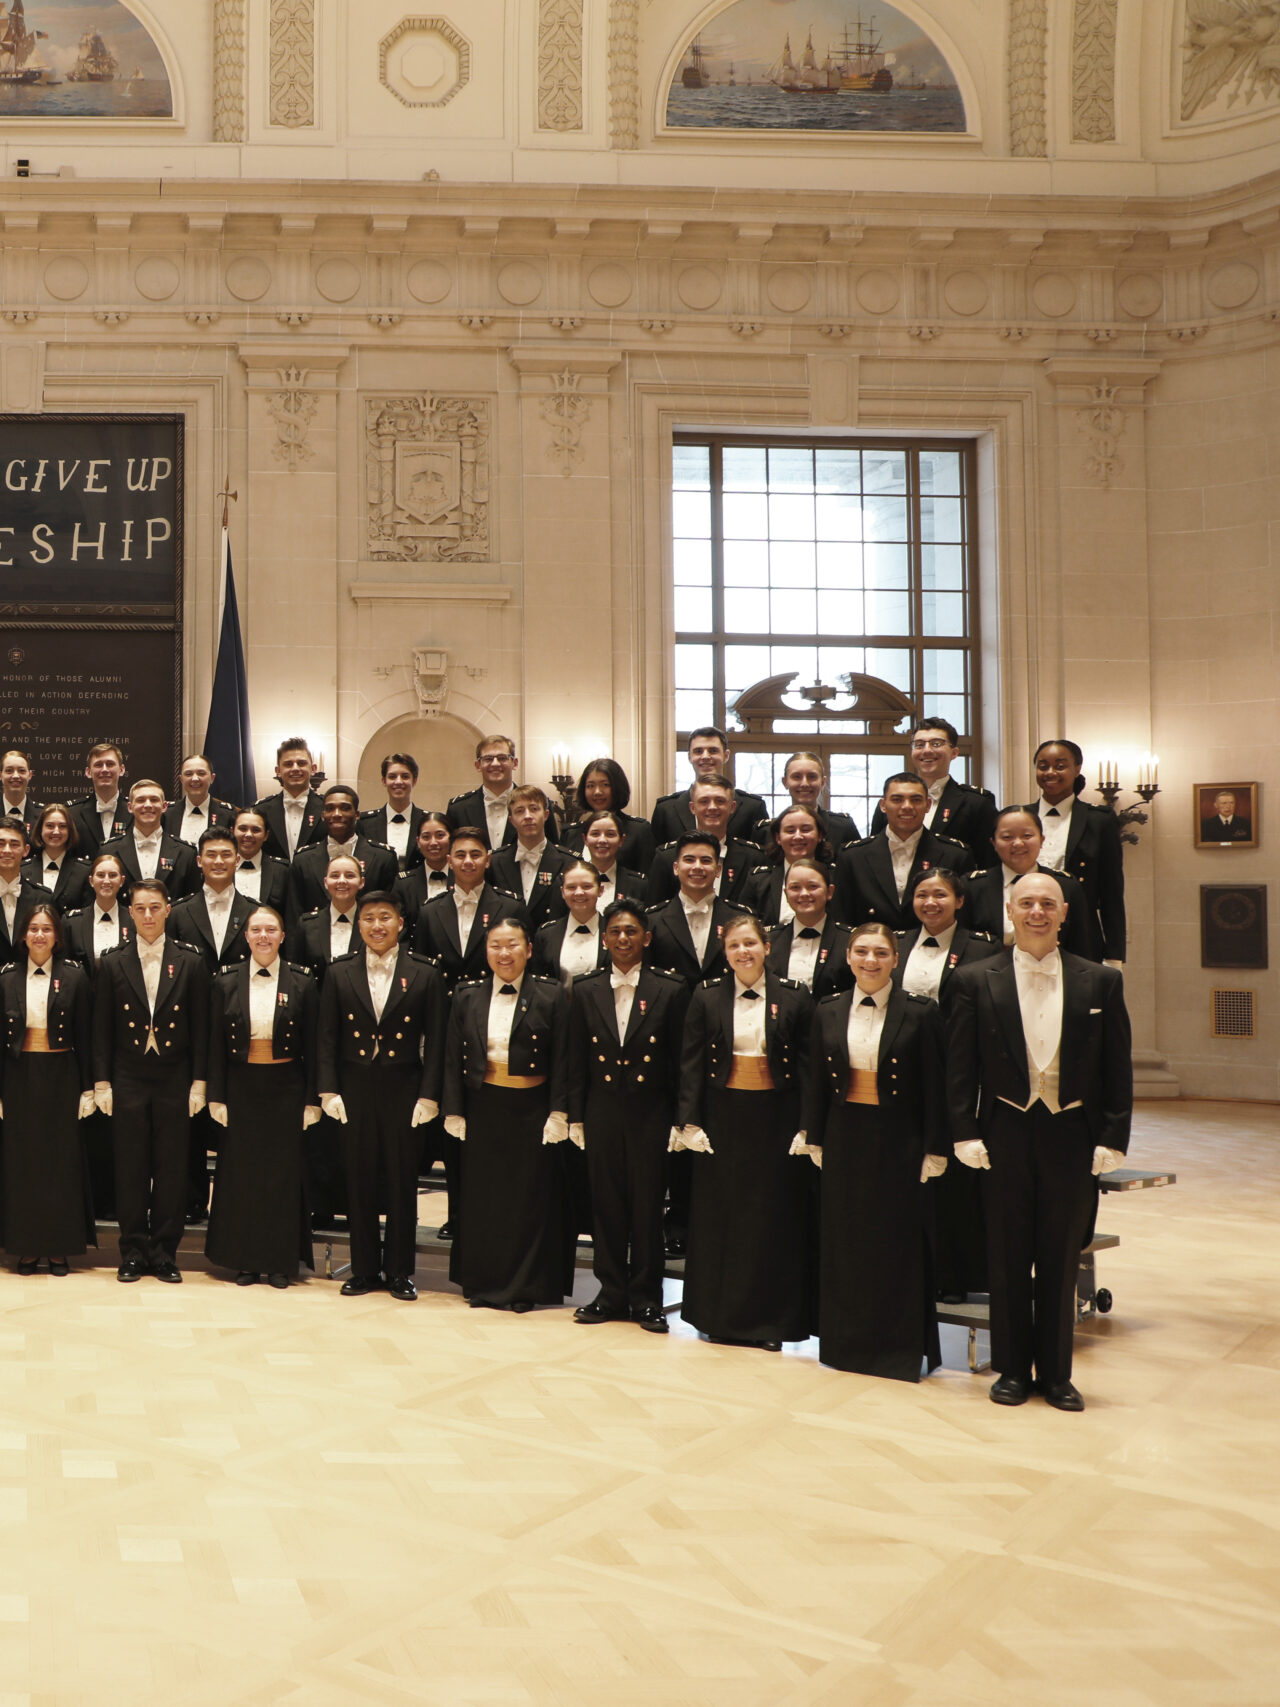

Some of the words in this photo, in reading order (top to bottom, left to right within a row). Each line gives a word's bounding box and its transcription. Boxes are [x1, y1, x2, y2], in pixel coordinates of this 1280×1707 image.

[5, 458, 111, 493] GIVE
[126, 457, 172, 492] UP
[29, 517, 171, 564] SHIP
[3, 674, 33, 682] HONOR
[89, 675, 122, 683] ALUMNI
